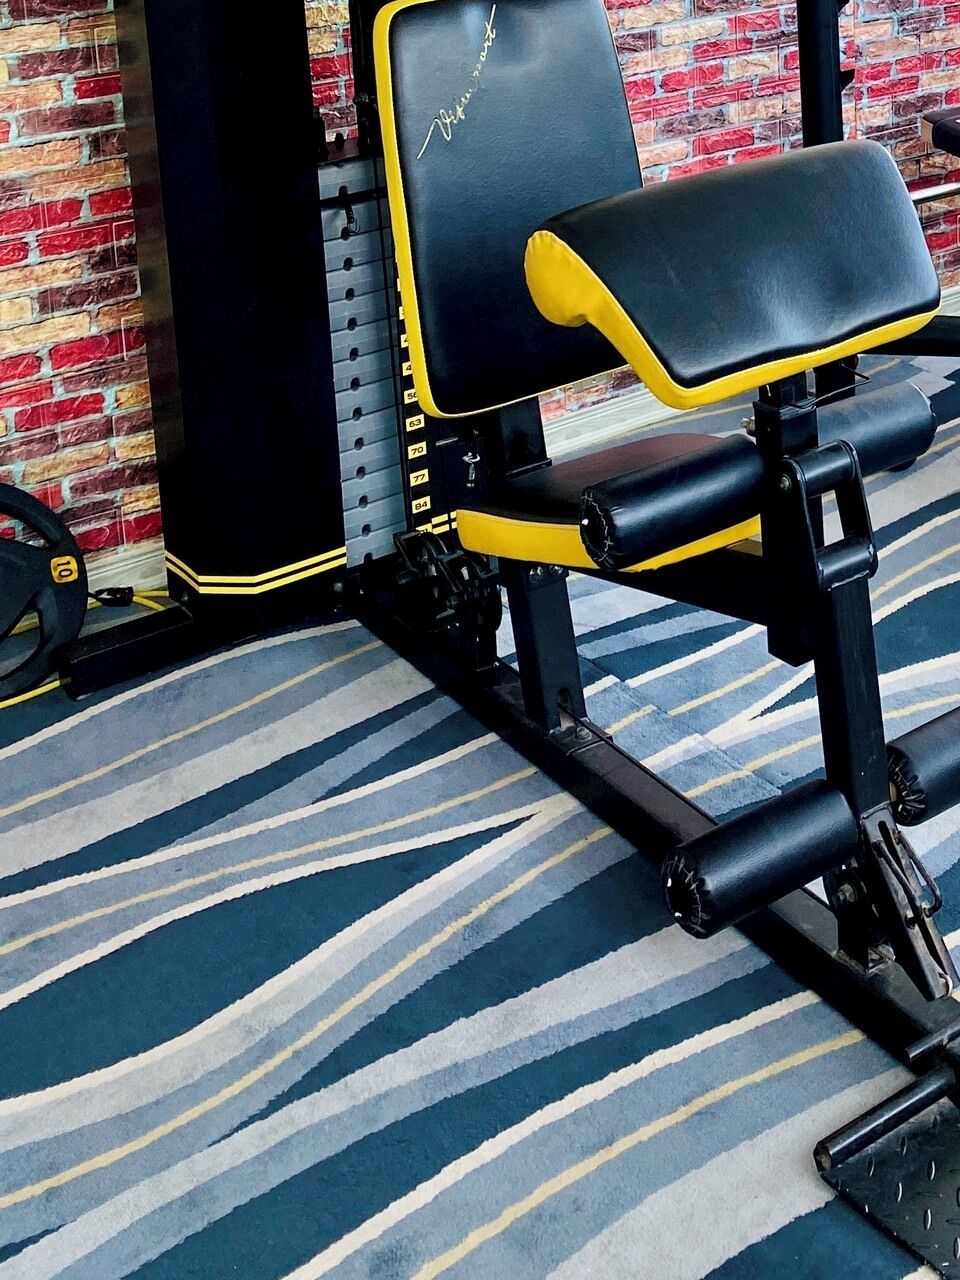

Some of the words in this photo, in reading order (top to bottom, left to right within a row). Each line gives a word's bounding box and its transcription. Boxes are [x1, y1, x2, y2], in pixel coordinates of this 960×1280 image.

[409, 418, 422, 428] 63
[411, 446, 424, 456] 70
[413, 473, 426, 483] 77
[415, 500, 428, 511] 84
[56, 560, 73, 579] 10
